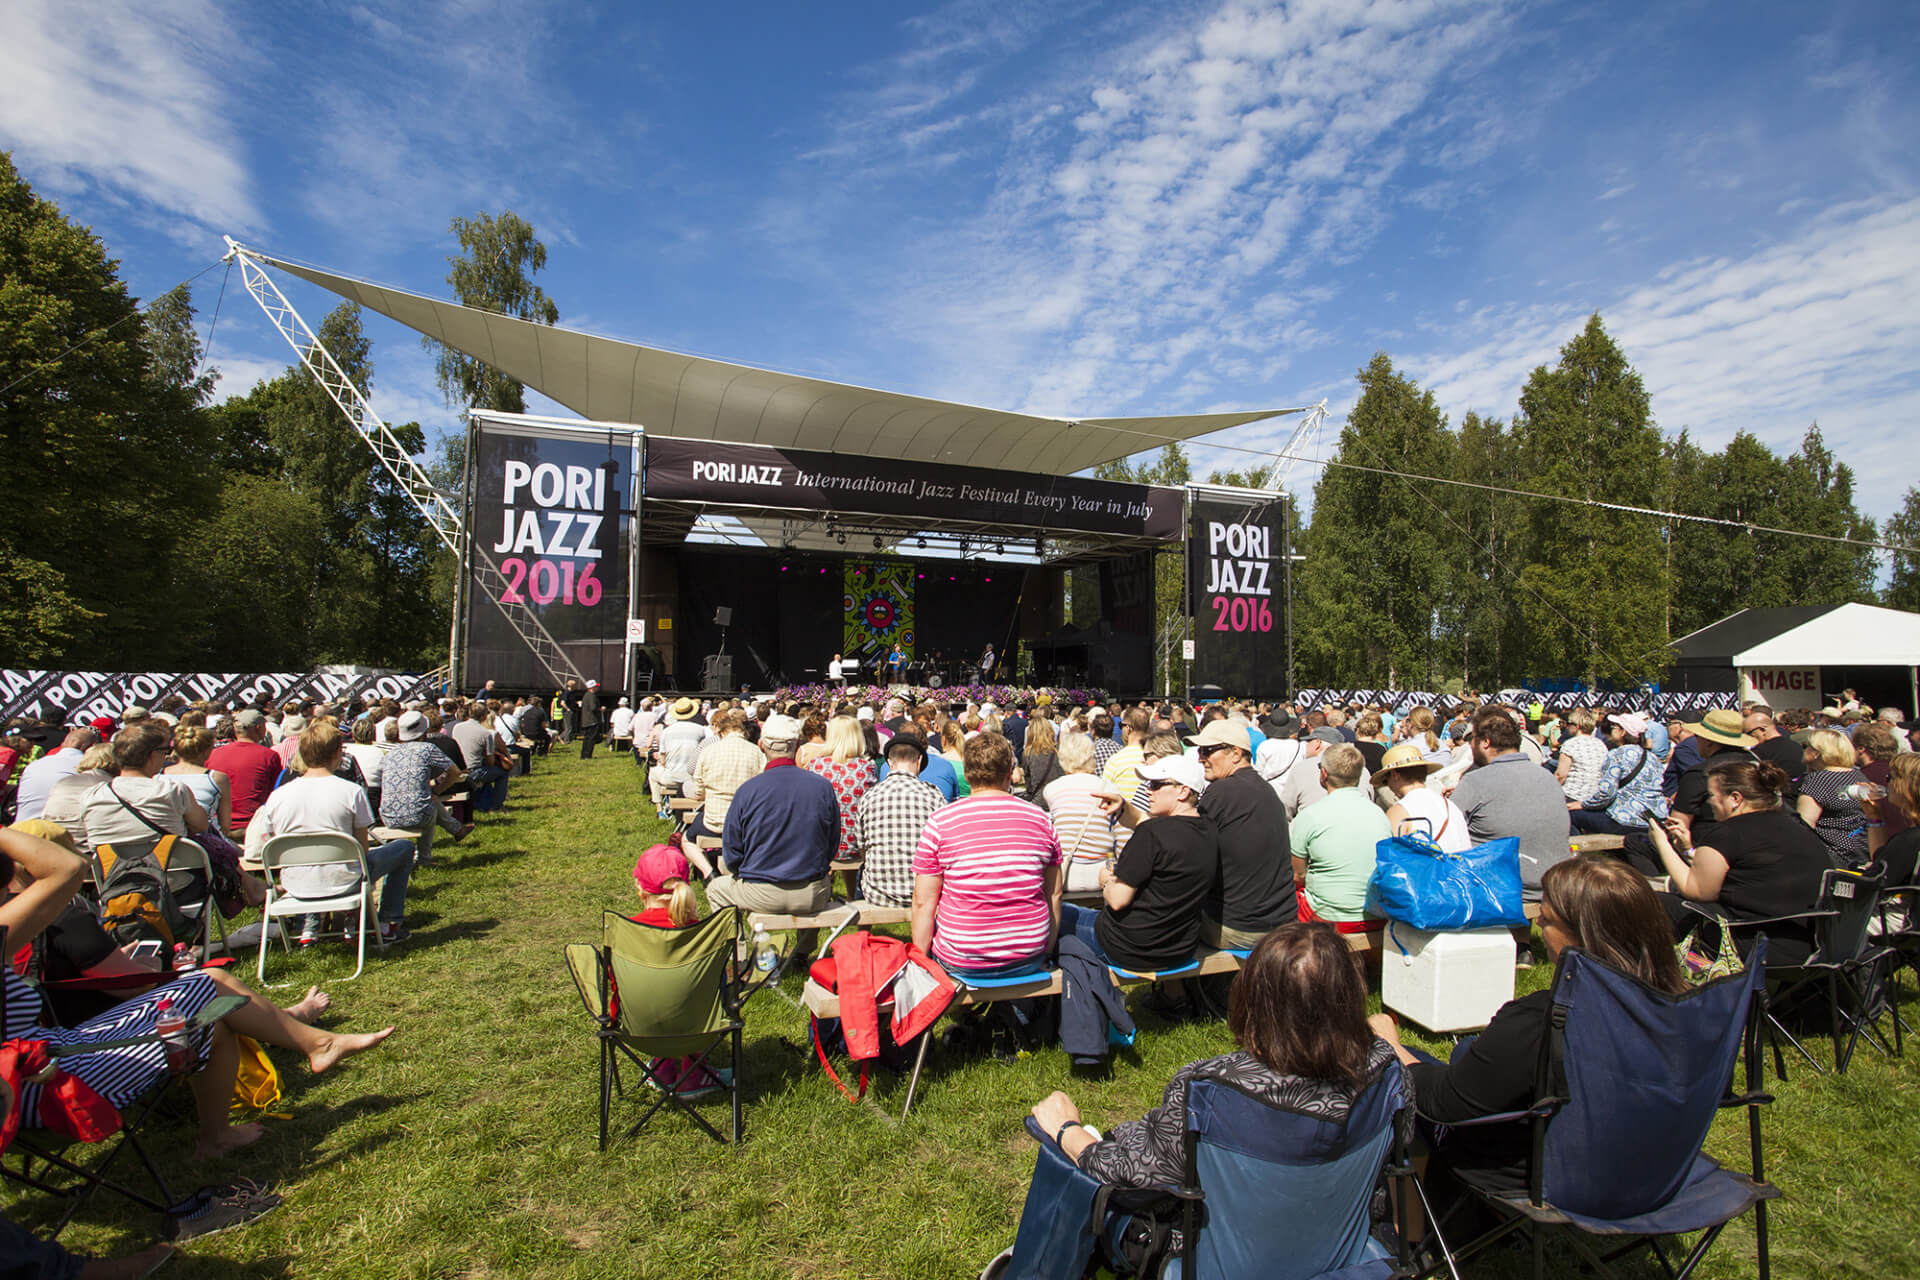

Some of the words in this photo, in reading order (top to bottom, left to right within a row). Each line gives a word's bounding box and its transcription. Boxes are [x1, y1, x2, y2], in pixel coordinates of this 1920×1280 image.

[504, 460, 606, 511] PORI
[693, 461, 735, 482] PORI
[738, 464, 783, 486] JAZZ
[794, 470, 916, 495] International
[916, 480, 955, 500] Jazz
[960, 485, 1020, 504] Festival
[1024, 490, 1066, 512] Every
[1071, 495, 1103, 512] Year
[1107, 499, 1122, 514] in
[1123, 501, 1154, 520] July
[494, 509, 605, 559] JAZZ
[1208, 521, 1270, 559] PORI
[498, 558, 603, 607] 2016
[1207, 558, 1272, 595] JAZZ
[1212, 596, 1273, 633] 2016
[1751, 670, 1816, 690] IMAGE
